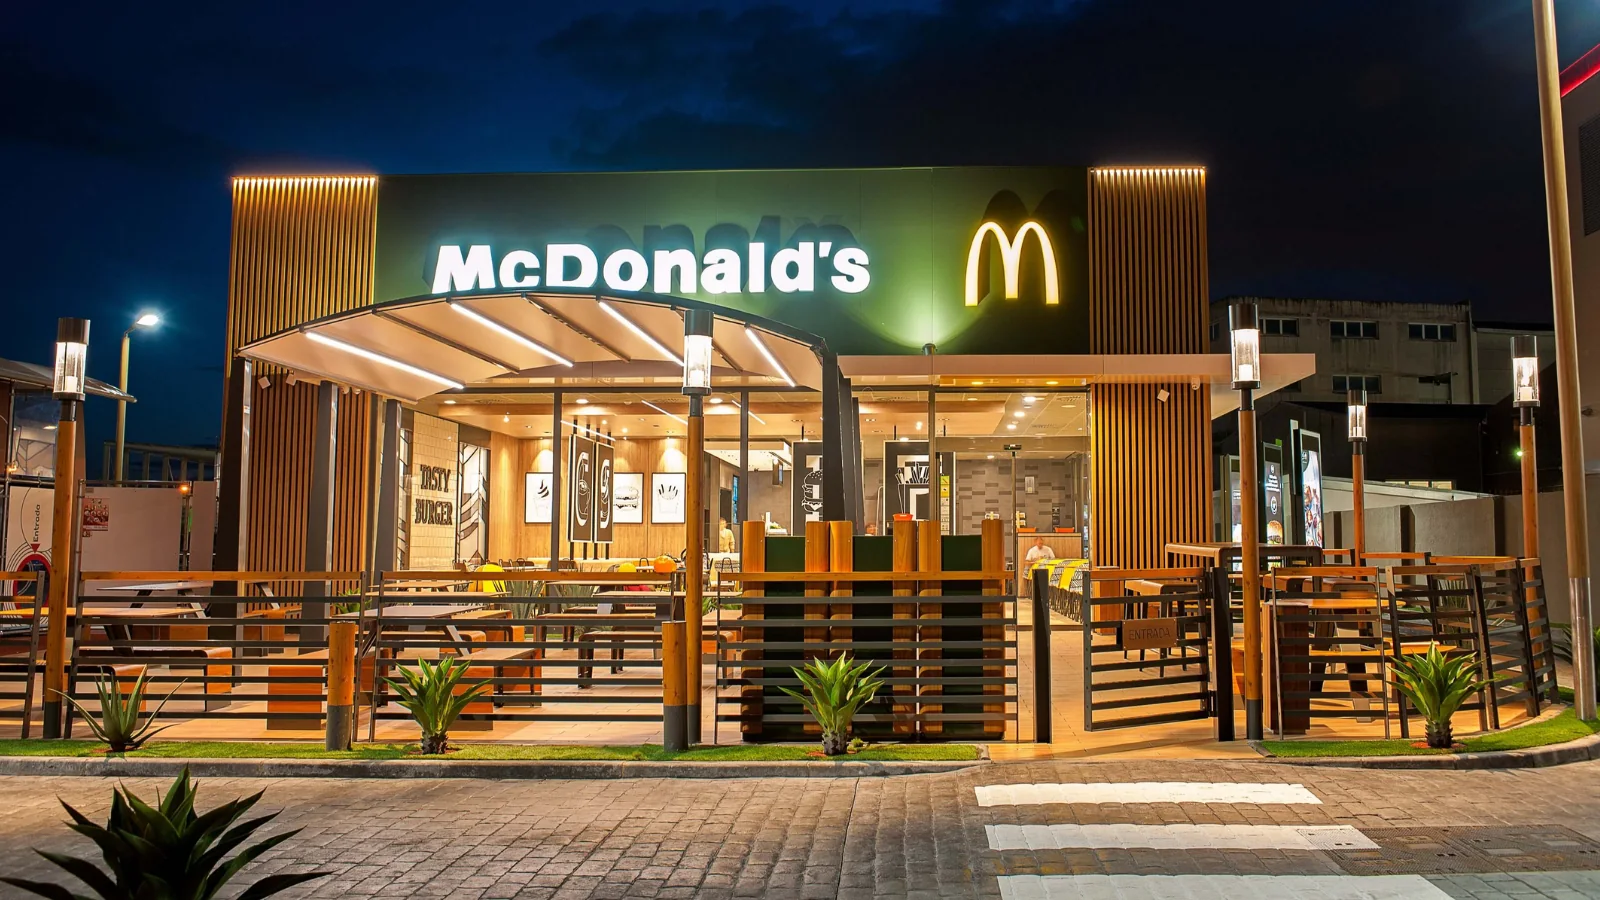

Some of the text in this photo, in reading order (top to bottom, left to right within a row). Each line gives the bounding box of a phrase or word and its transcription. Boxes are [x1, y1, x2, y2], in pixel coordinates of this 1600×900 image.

[432, 242, 871, 294] McDonald's
[420, 464, 451, 493] TASTY
[33, 504, 41, 542] Entrada
[415, 498, 453, 526] BURGER
[1129, 628, 1170, 641] ENTRADA
